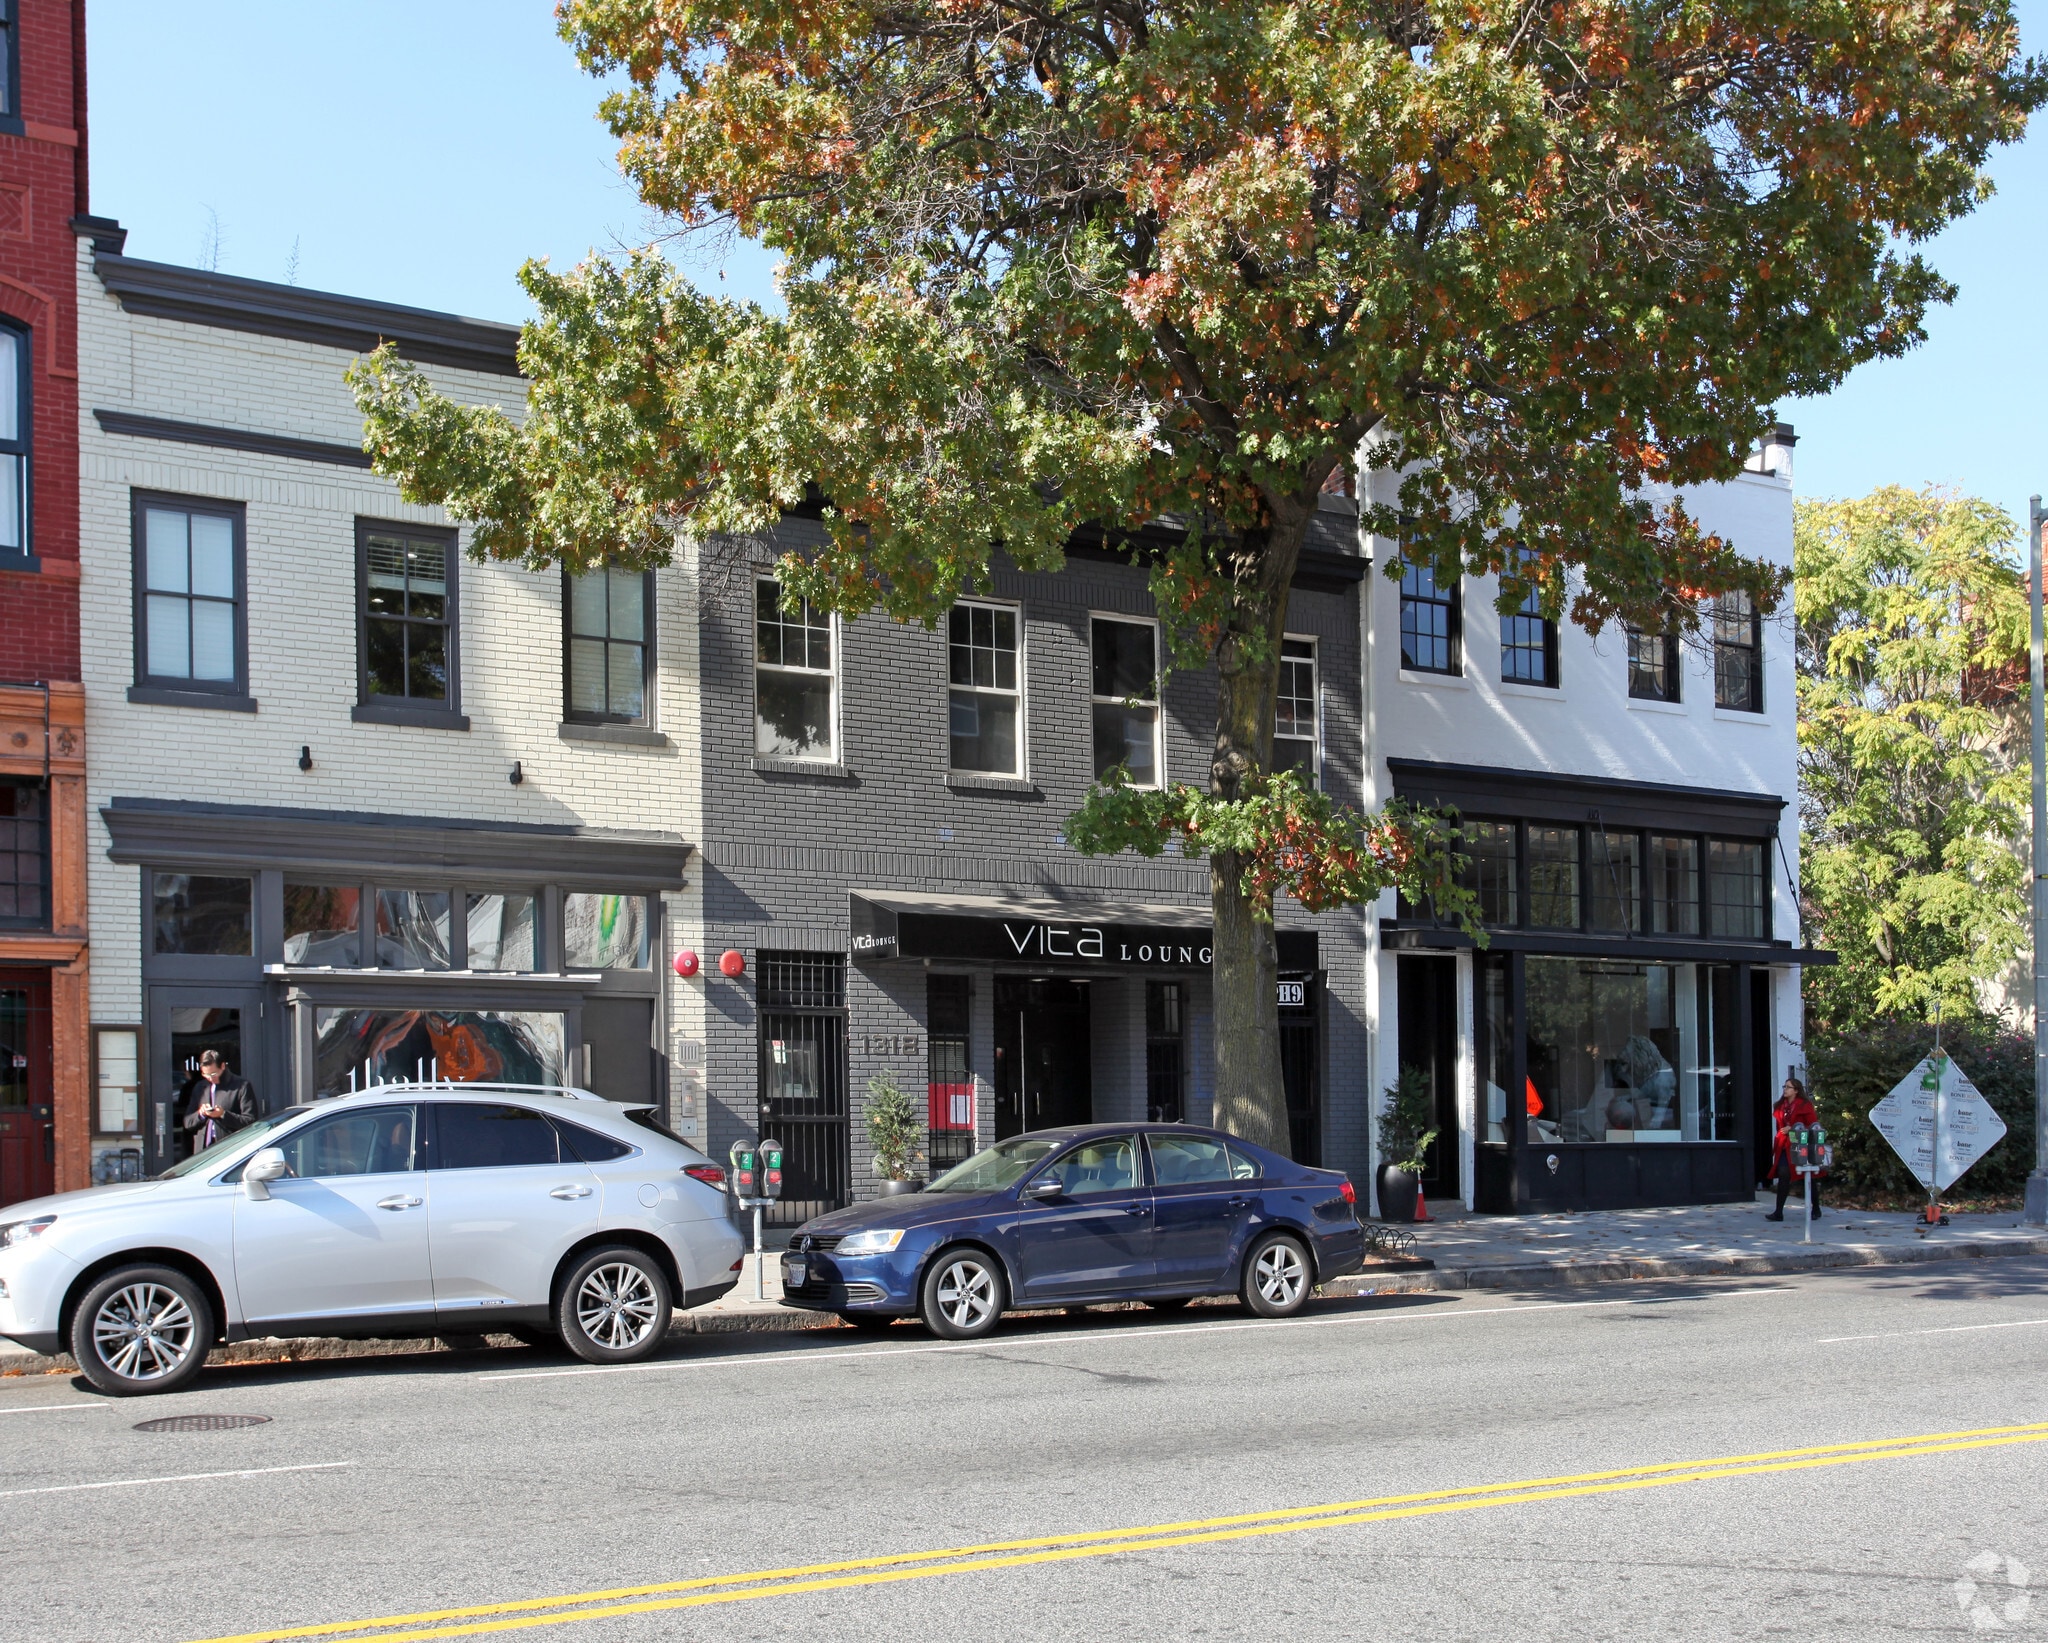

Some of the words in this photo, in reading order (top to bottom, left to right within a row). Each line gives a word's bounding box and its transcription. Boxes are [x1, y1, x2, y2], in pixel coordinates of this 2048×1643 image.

[872, 936, 896, 947] LOUNGE
[1120, 944, 1213, 964] LOUNG
[860, 1034, 918, 1056] 1318
[742, 1154, 749, 1164] 2
[770, 1152, 777, 1163] 2
